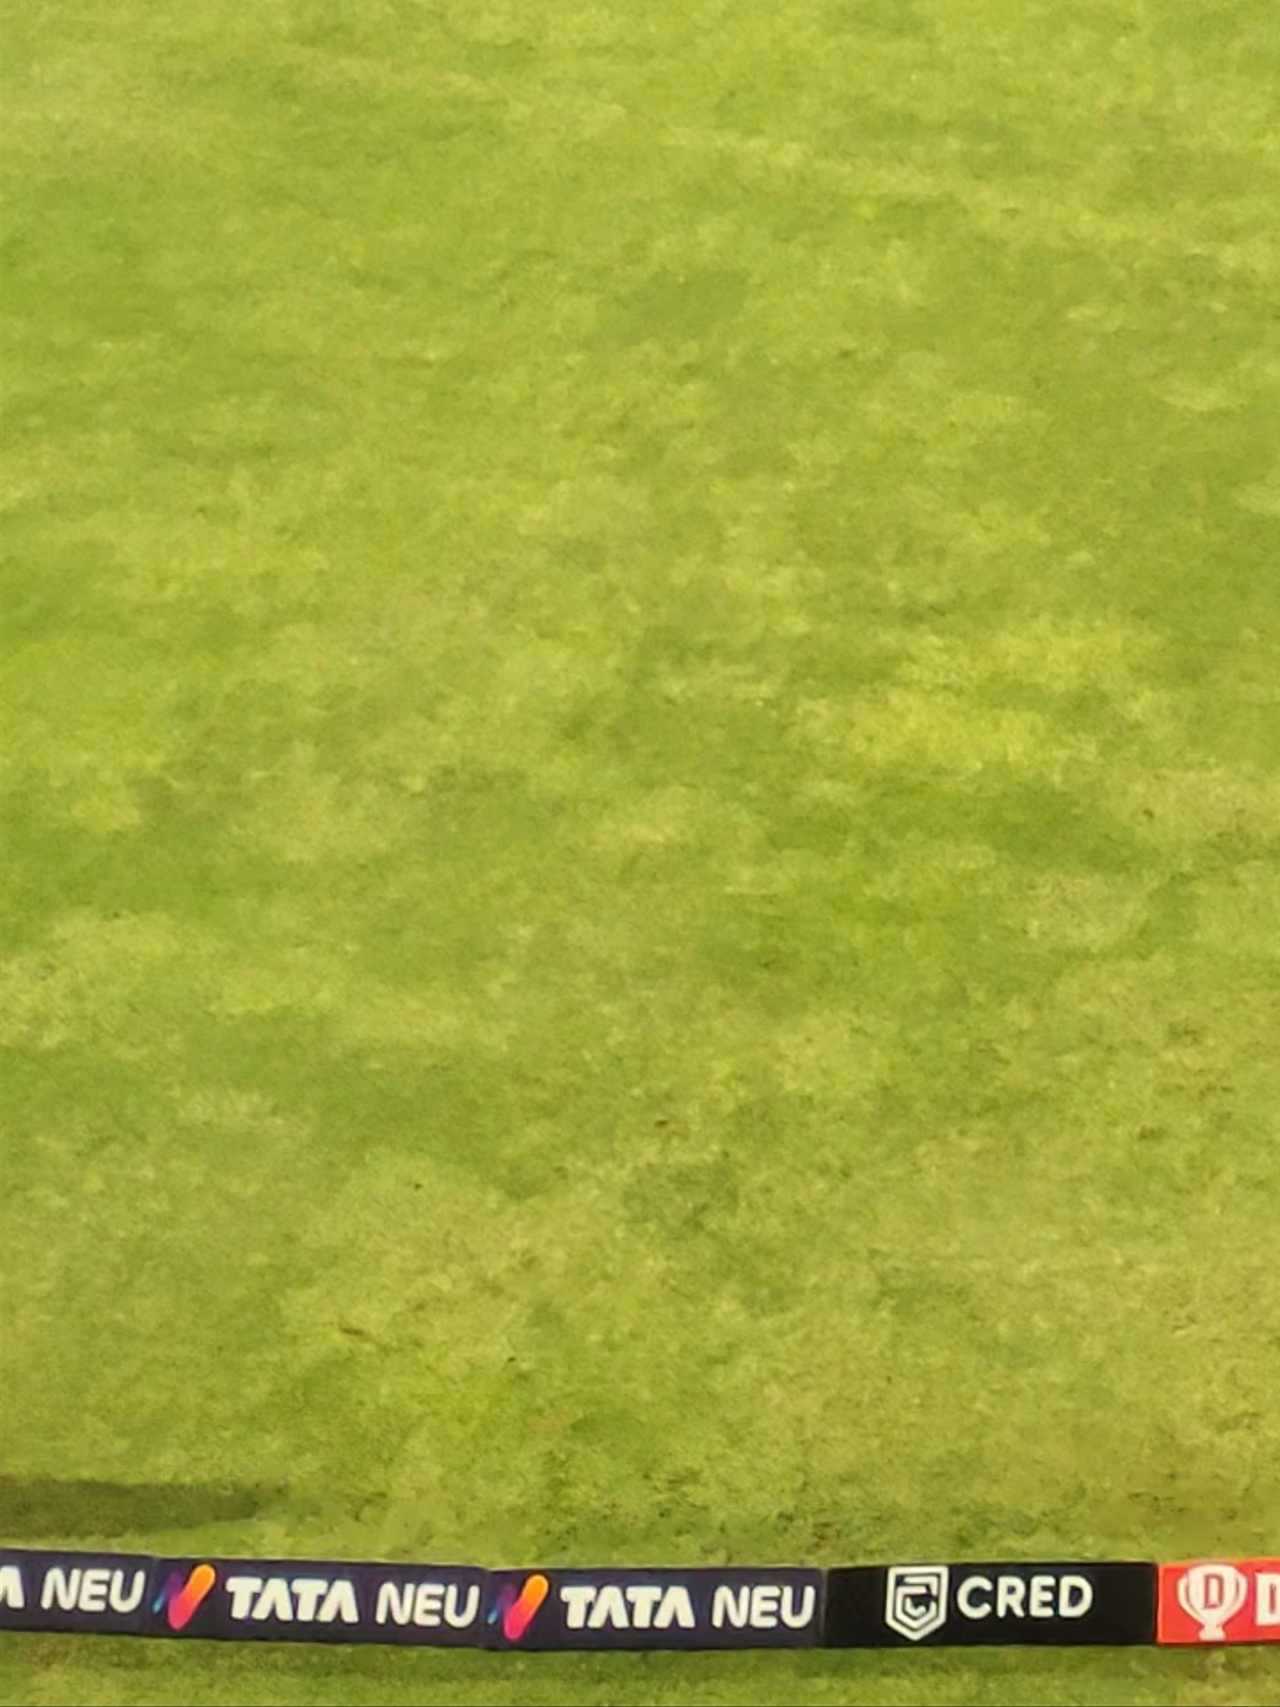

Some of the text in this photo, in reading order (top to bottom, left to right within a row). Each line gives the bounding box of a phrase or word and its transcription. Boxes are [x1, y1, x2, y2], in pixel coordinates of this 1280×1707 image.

[41, 1568, 145, 1612] NEU
[226, 1577, 480, 1628] TATA NEU
[560, 1584, 815, 1629] TATA NEU
[957, 1575, 1093, 1621] CRED
